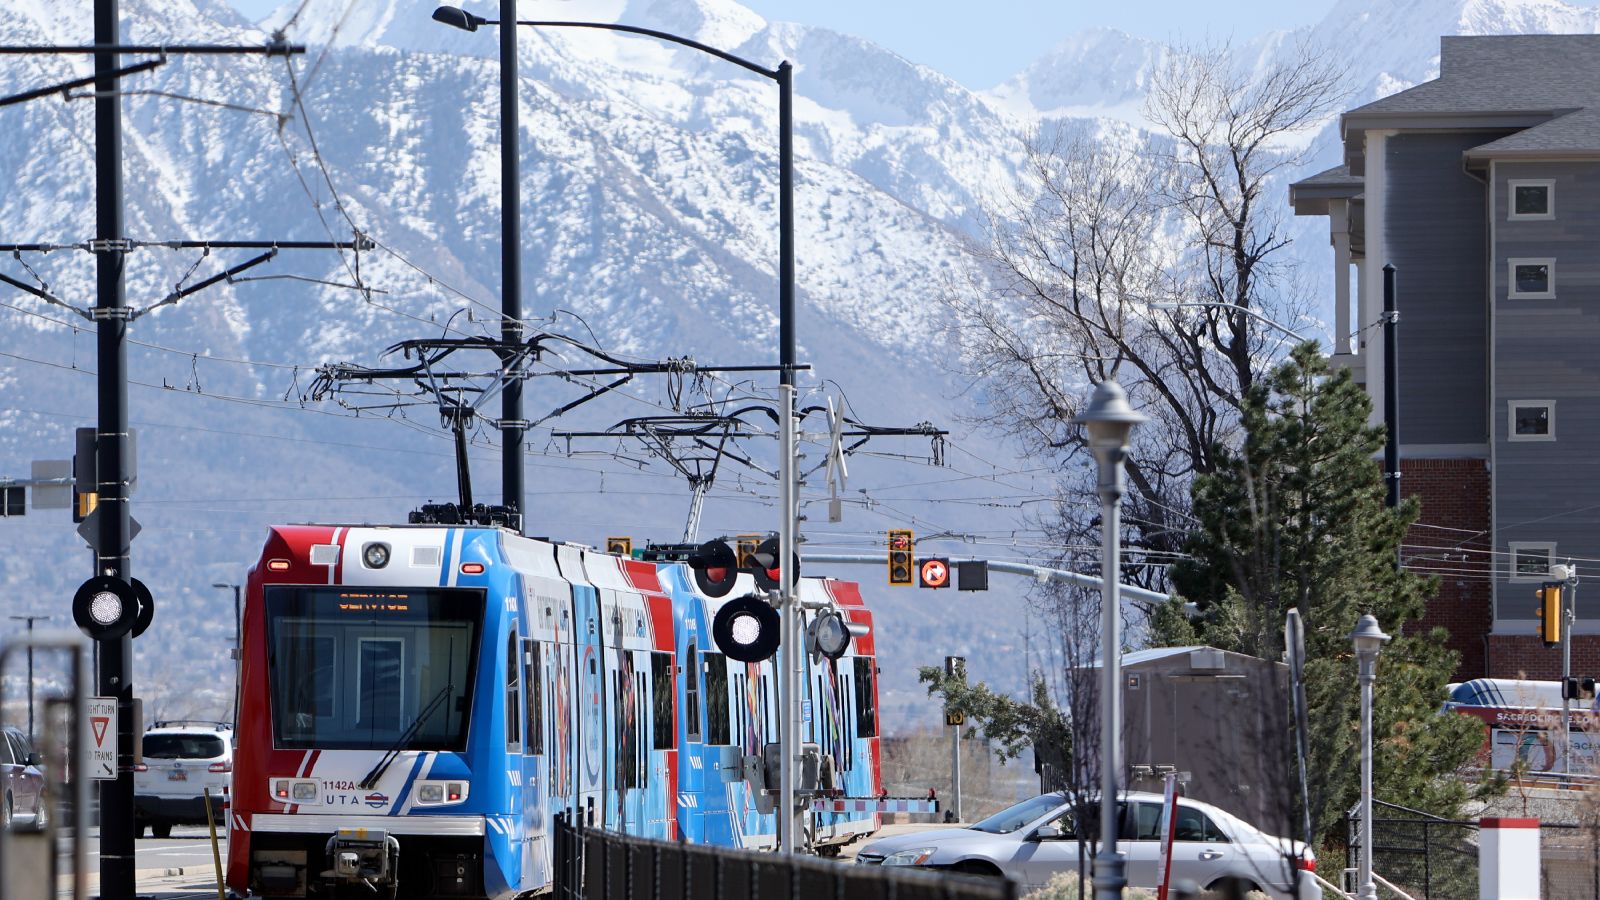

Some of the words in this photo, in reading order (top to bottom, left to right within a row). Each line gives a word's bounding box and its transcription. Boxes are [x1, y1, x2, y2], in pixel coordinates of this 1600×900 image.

[87, 704, 99, 714] IGHT
[101, 704, 115, 714] TURN
[94, 751, 113, 761] TRAINS
[322, 781, 355, 790] 1142A
[326, 795, 359, 804] UTA
